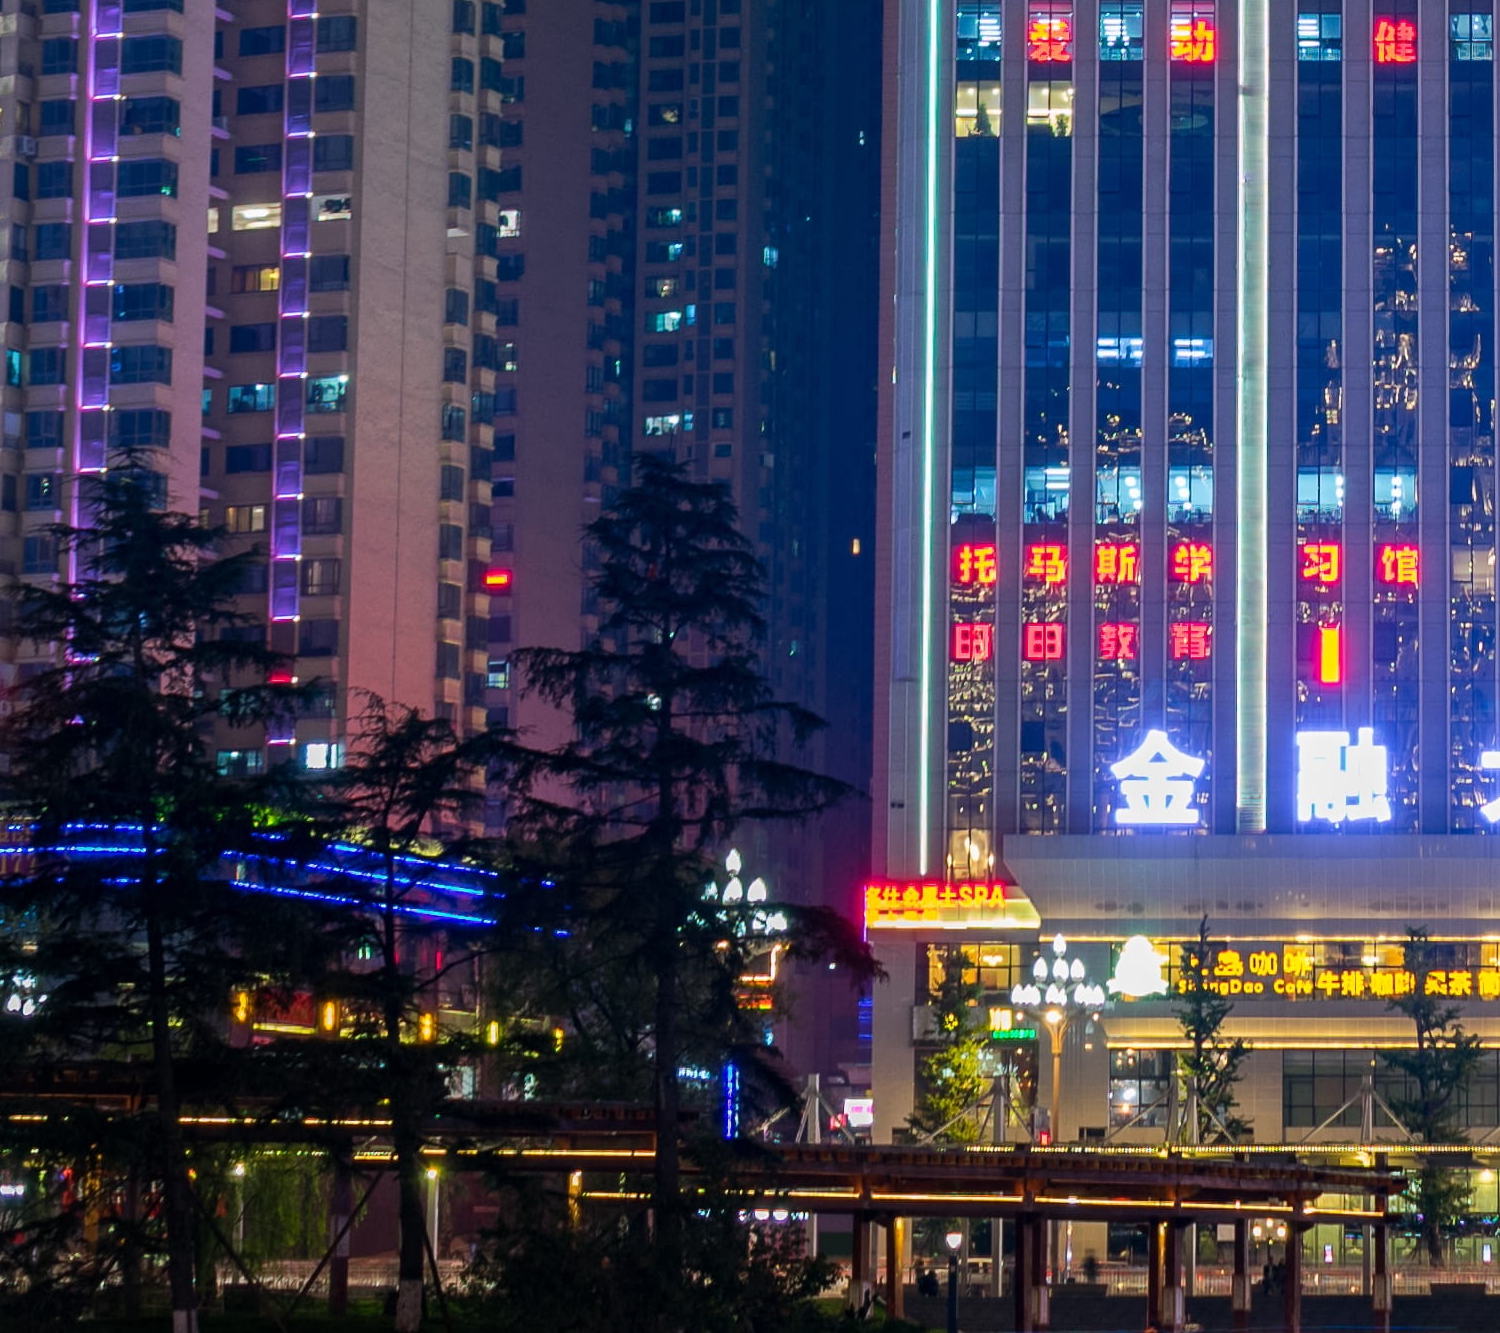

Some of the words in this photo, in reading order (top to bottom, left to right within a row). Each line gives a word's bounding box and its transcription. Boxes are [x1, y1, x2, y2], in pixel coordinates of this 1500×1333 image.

[959, 544, 1419, 584] 托马斯学习馆
[1178, 949, 1314, 977] 岛咖啡
